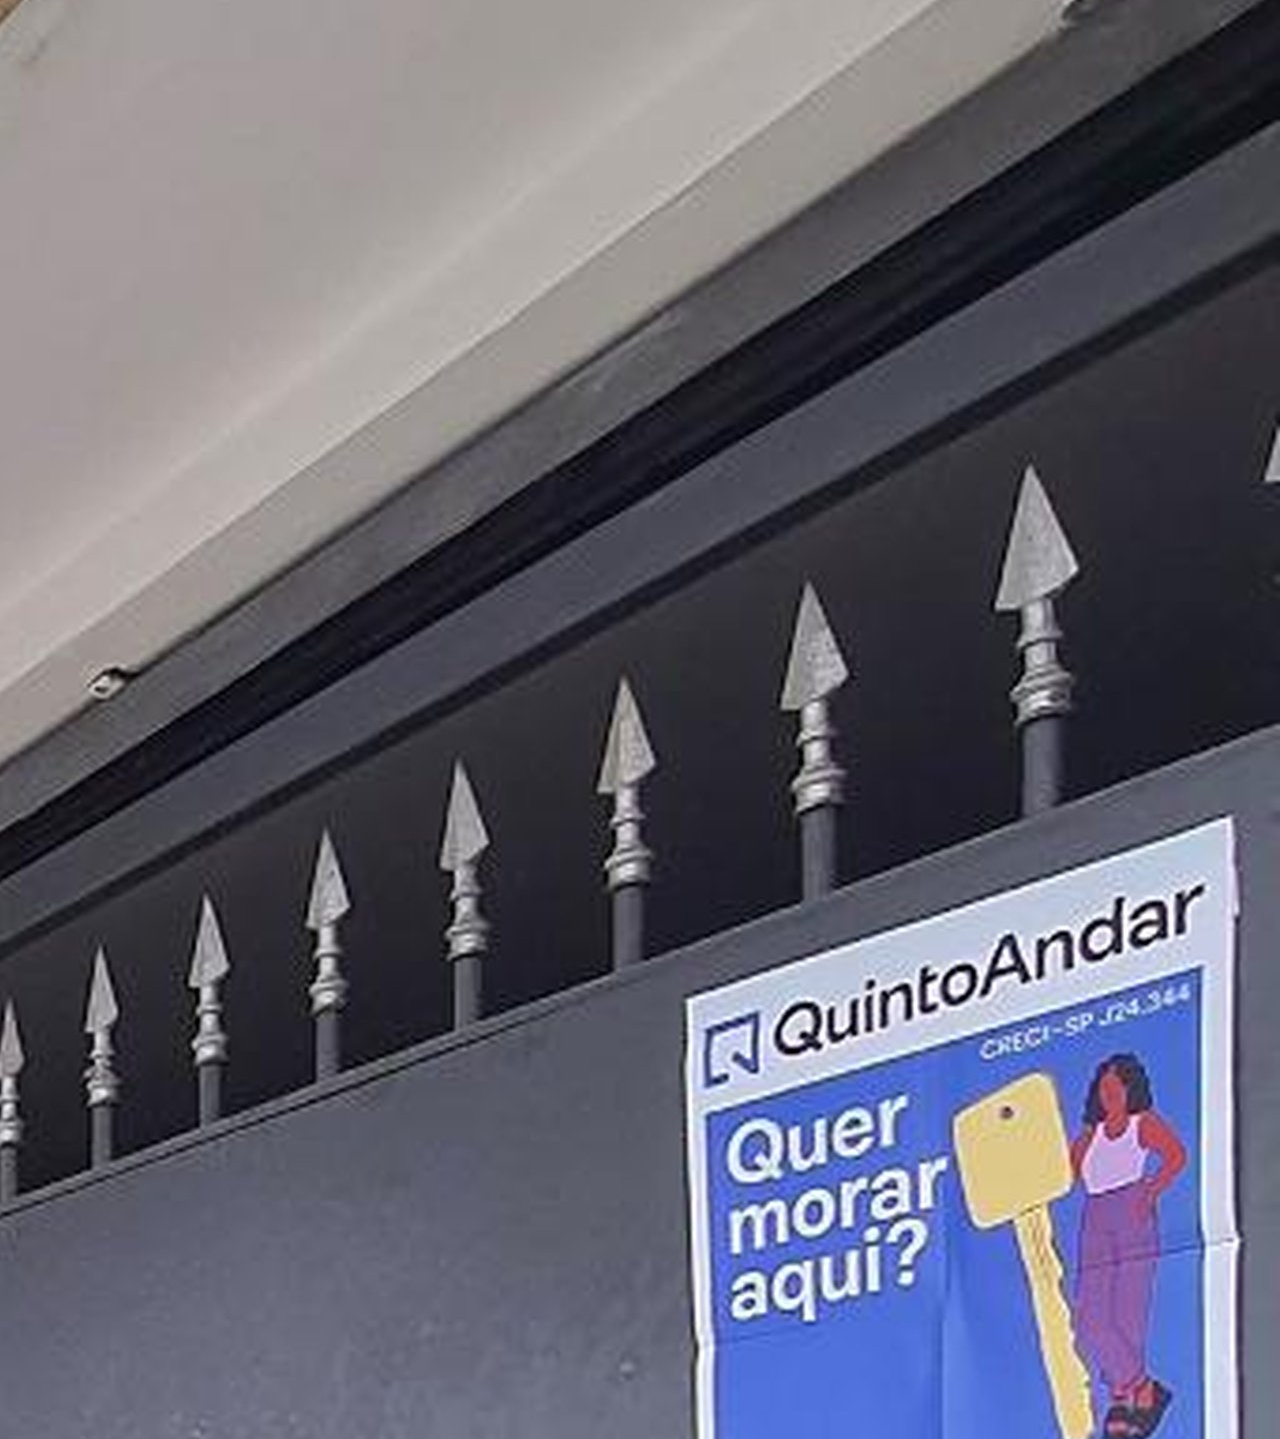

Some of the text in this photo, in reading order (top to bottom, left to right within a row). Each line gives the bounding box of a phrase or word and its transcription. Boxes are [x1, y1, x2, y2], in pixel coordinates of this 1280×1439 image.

[773, 883, 1205, 1056] QuintoAndar
[979, 1013, 1094, 1060] CRECI-SP
[727, 1094, 909, 1184] Quer
[729, 1156, 948, 1255] morar
[730, 1218, 928, 1322] aqui?
